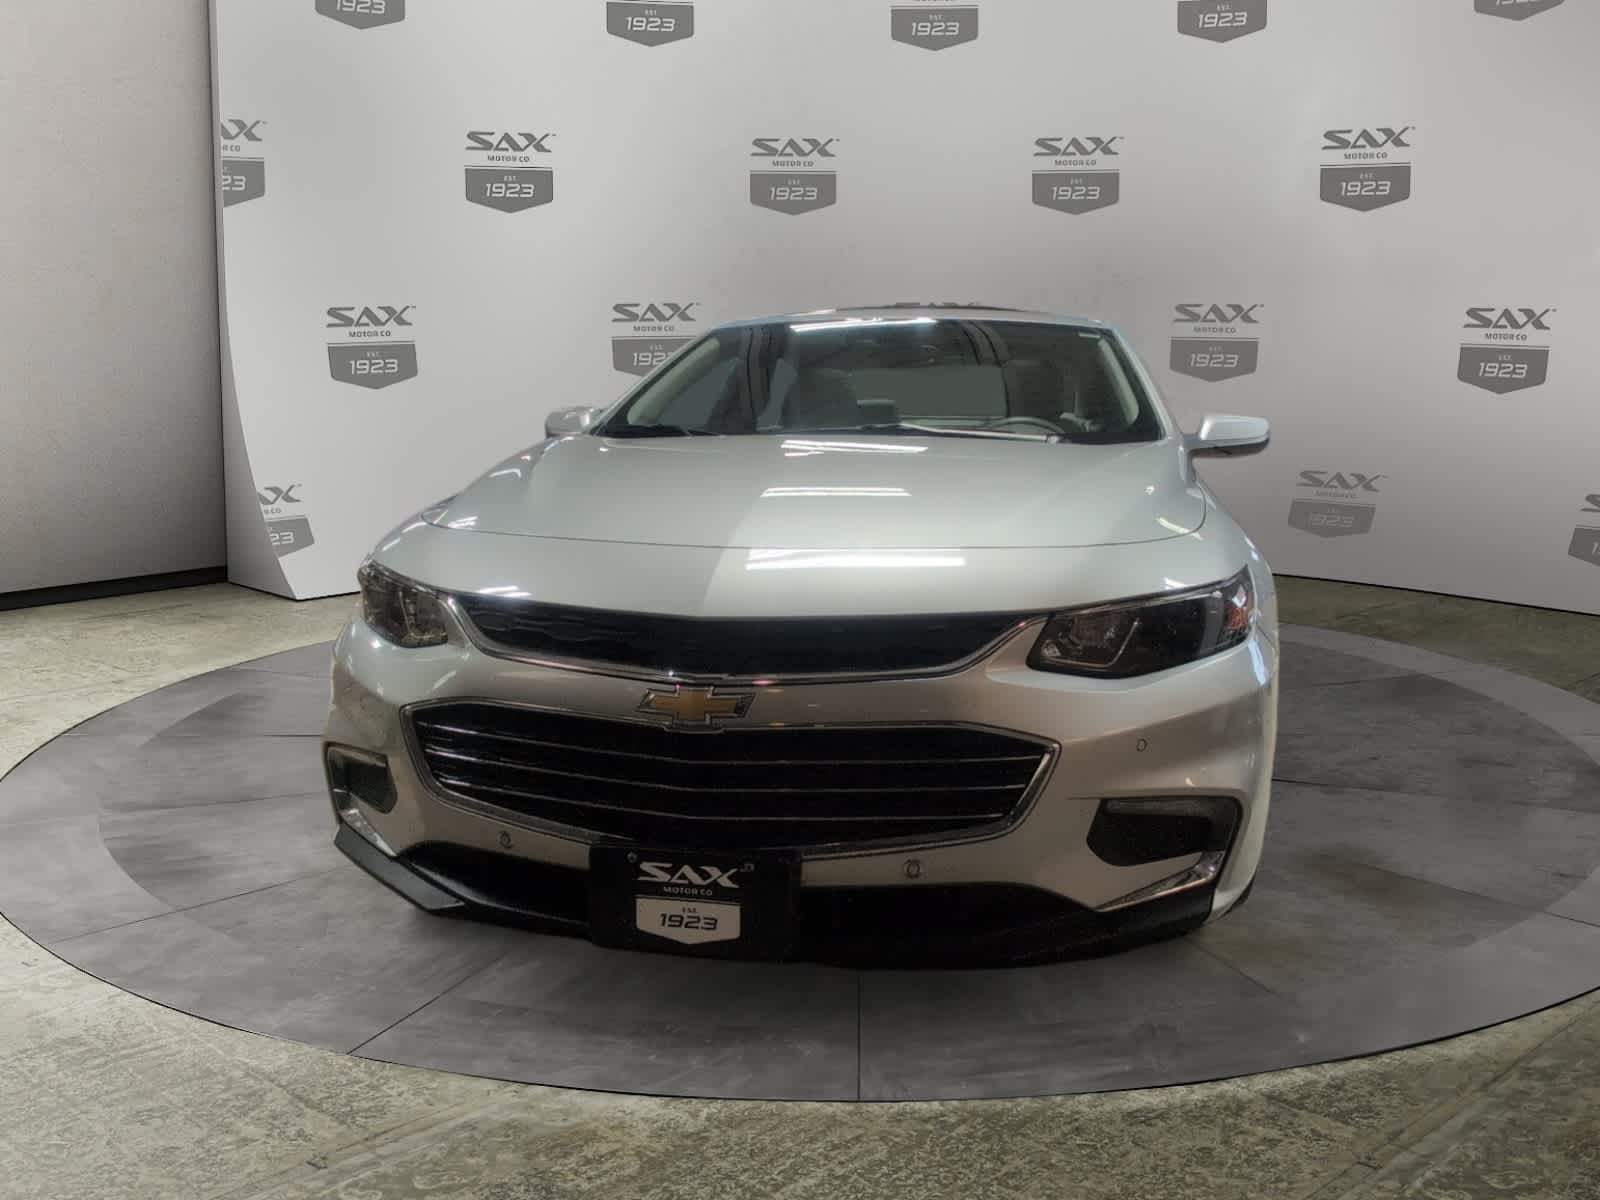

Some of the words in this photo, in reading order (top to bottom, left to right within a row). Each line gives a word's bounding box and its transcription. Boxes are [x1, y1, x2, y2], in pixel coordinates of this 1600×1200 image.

[336, 0, 385, 14] 1923
[626, 17, 676, 32] 1923
[1199, 12, 1247, 28] 1923
[912, 22, 960, 36] 1923
[221, 119, 262, 142] AX
[466, 131, 552, 152] SAX
[1321, 127, 1411, 150] SAX
[750, 138, 835, 157] SAX
[1034, 137, 1119, 156] SAX
[222, 176, 246, 191] 23
[485, 183, 534, 198] 1923
[1340, 181, 1391, 196] 1923
[770, 187, 818, 200] 1923
[1052, 186, 1100, 200] 1923
[326, 305, 412, 328] SAX
[612, 302, 696, 322] SAX
[1173, 304, 1259, 324] SAX
[1463, 308, 1551, 330] SAX
[349, 360, 398, 374] 1923
[1190, 354, 1238, 367] 1923
[1478, 363, 1528, 378] 1923
[1296, 470, 1380, 492] SAX
[257, 484, 301, 505] AX
[1306, 514, 1355, 528] 923
[270, 531, 294, 545] 23
[638, 862, 739, 888] SAX
[664, 886, 698, 896] MOTOR
[700, 888, 713, 896] CO
[660, 913, 718, 931] 1923
